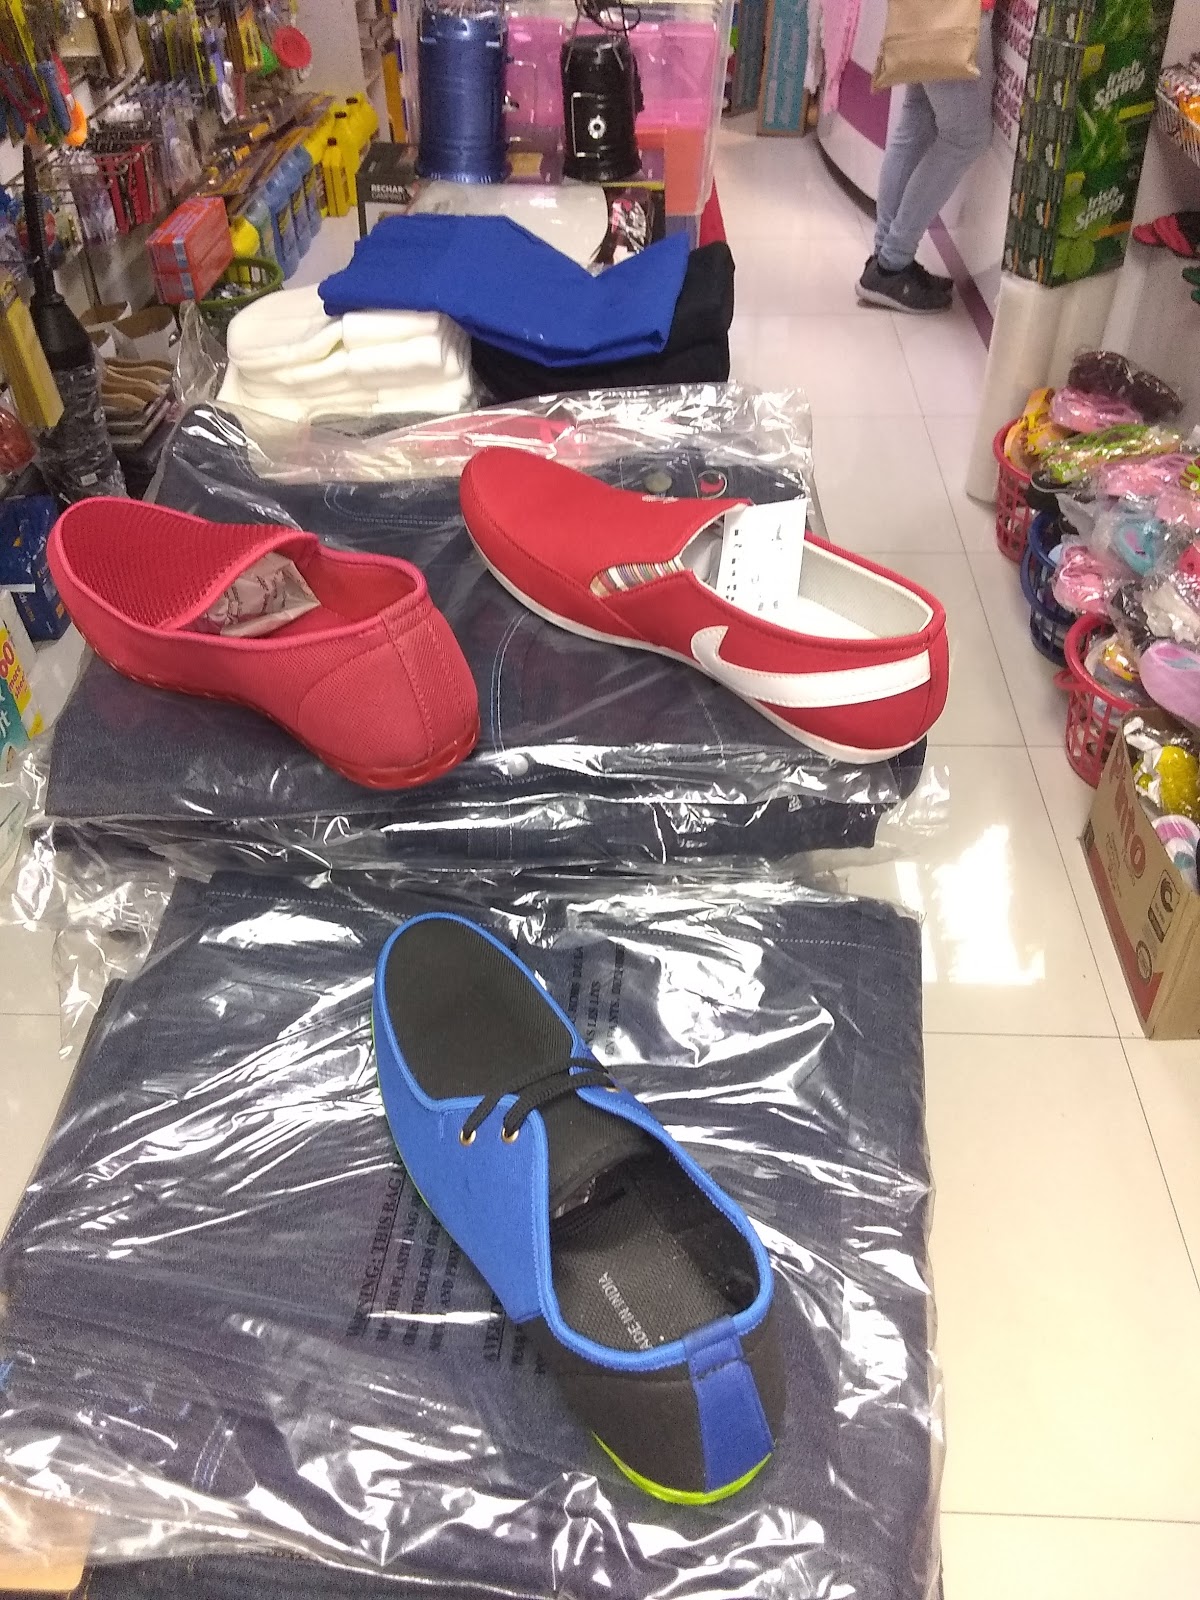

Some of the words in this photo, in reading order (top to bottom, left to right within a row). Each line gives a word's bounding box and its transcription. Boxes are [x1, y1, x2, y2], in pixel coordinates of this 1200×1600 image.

[371, 184, 405, 194] RECHAR
[381, 1176, 401, 1214] BAG
[371, 1214, 393, 1254] THIS
[598, 1271, 625, 1309] INDIA
[618, 1306, 635, 1324] IN
[627, 1321, 654, 1350] ADE
